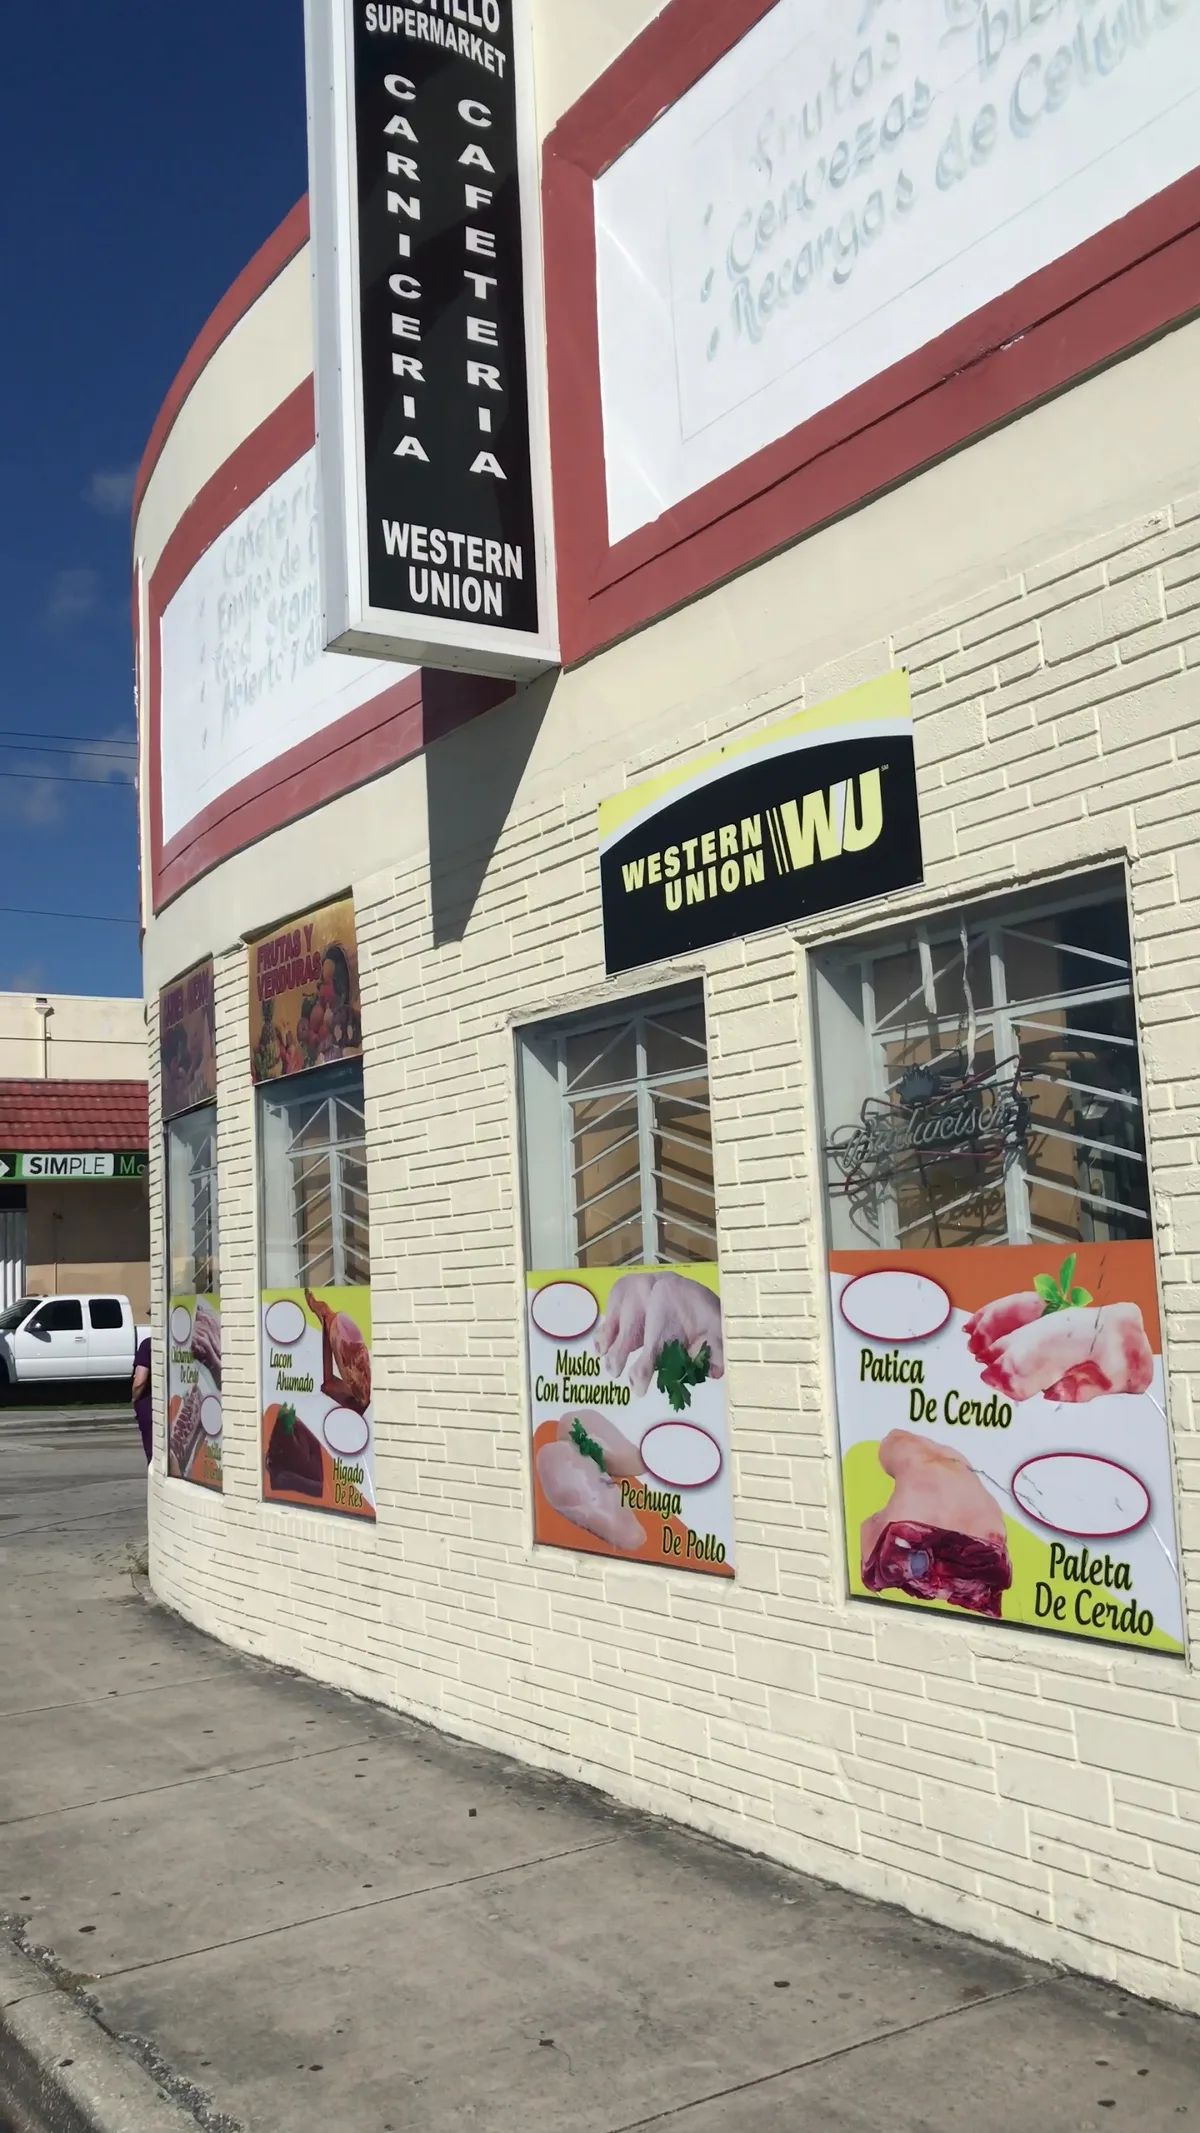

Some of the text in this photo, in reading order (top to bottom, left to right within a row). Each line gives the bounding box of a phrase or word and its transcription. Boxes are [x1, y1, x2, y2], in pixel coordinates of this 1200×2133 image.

[365, 3, 506, 78] SUPERMARKET
[383, 74, 430, 463] CARNICERIA
[457, 99, 507, 480] CAFETERIA
[382, 519, 523, 580] WESTERN
[409, 566, 503, 617] UNION
[780, 767, 883, 871] WU
[621, 813, 763, 893] WESTERN
[664, 849, 765, 912] UNION
[257, 922, 314, 974] FRUTAS Y
[256, 951, 321, 1002] VERDURAS
[29, 1156, 105, 1175] SIMPLE
[269, 1347, 293, 1368] Lacon
[276, 1370, 314, 1393] Ahumado
[555, 1348, 601, 1377] Muslos
[859, 1348, 925, 1385] Patica
[535, 1375, 631, 1406] Con Encuentro
[909, 1387, 1013, 1430] De Cerdo
[333, 1457, 365, 1486] Higado
[334, 1484, 364, 1508] De Res
[619, 1479, 683, 1522] Pechuga
[662, 1525, 726, 1564] De Pollo
[1050, 1542, 1133, 1590] Paleta
[1035, 1581, 1154, 1636] De Cerdo
